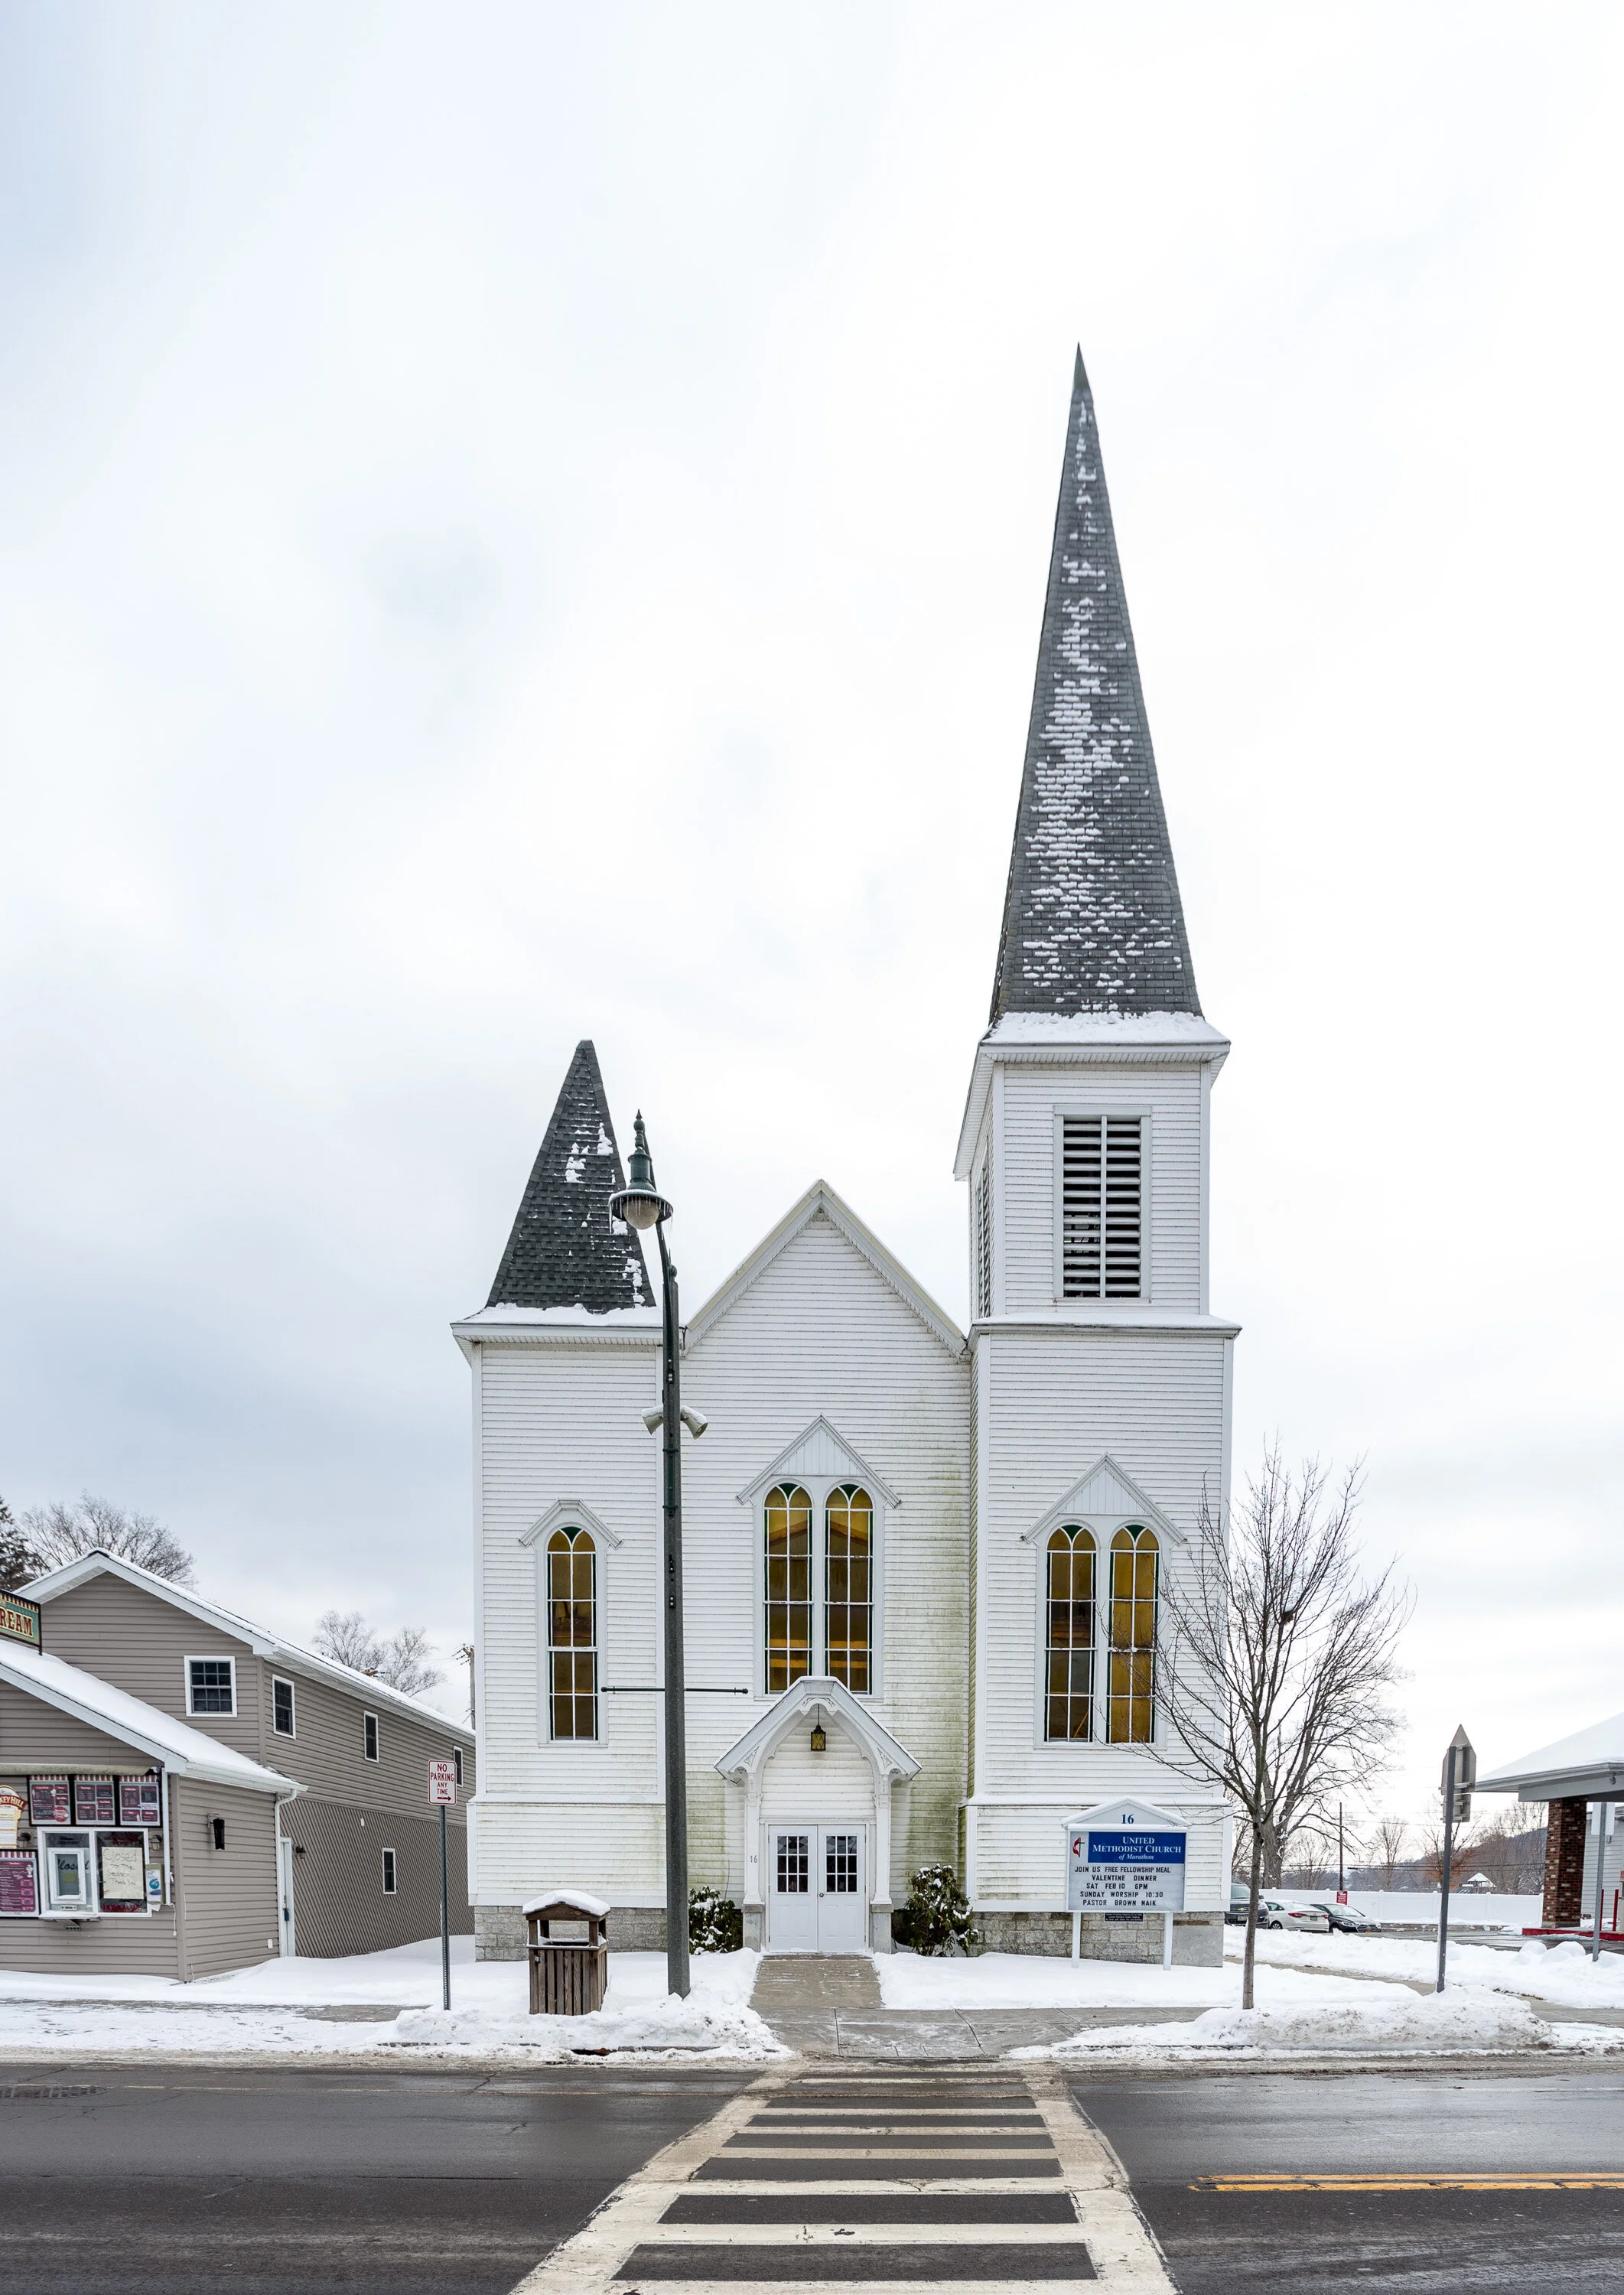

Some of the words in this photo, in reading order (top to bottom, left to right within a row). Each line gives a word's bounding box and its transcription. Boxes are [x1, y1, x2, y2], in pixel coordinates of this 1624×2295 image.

[437, 1763, 447, 1772] NO
[430, 1773, 454, 1782] PARKING
[11, 1796, 24, 1808] HILL
[1121, 1814, 1134, 1824] 16
[1122, 1836, 1155, 1844] UNITED
[750, 1855, 758, 1864] 16
